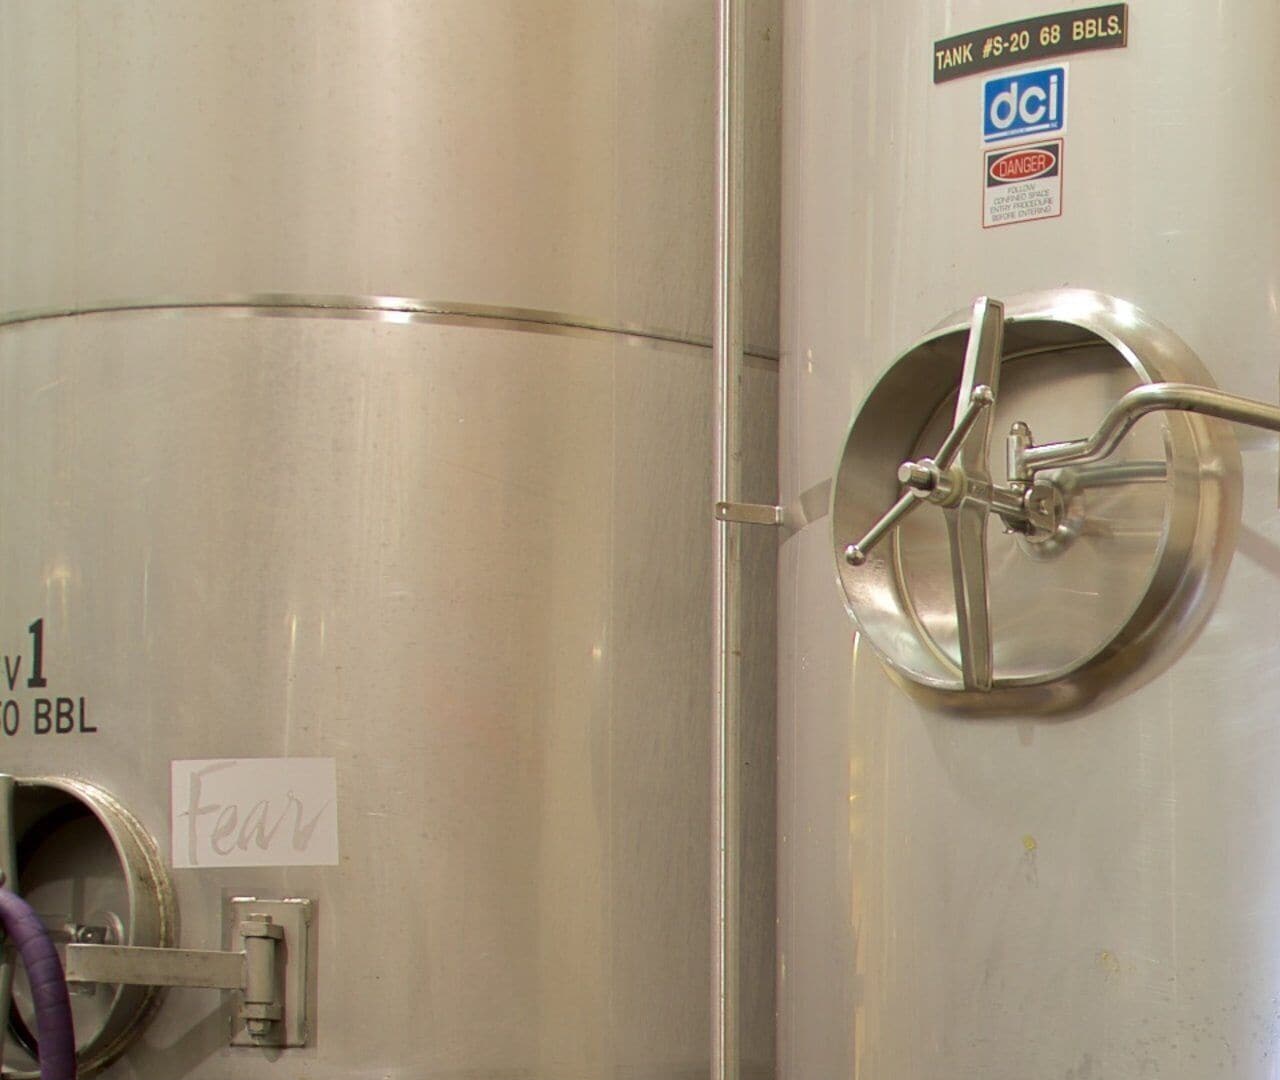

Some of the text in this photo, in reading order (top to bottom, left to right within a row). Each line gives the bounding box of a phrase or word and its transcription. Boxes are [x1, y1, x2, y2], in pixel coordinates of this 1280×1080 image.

[935, 16, 1122, 71] TANK #S-20 68 BBLS.
[989, 74, 1058, 130] dci
[999, 154, 1046, 177] DANGER
[993, 188, 1050, 205] CONFINED SPACE
[1007, 183, 1036, 194] FOLLOW
[990, 197, 1054, 214] ENTRY PROCEDURE
[991, 212, 1017, 222] BEFORE
[0, 697, 97, 736] 0 BBL
[178, 760, 330, 865] Fear
